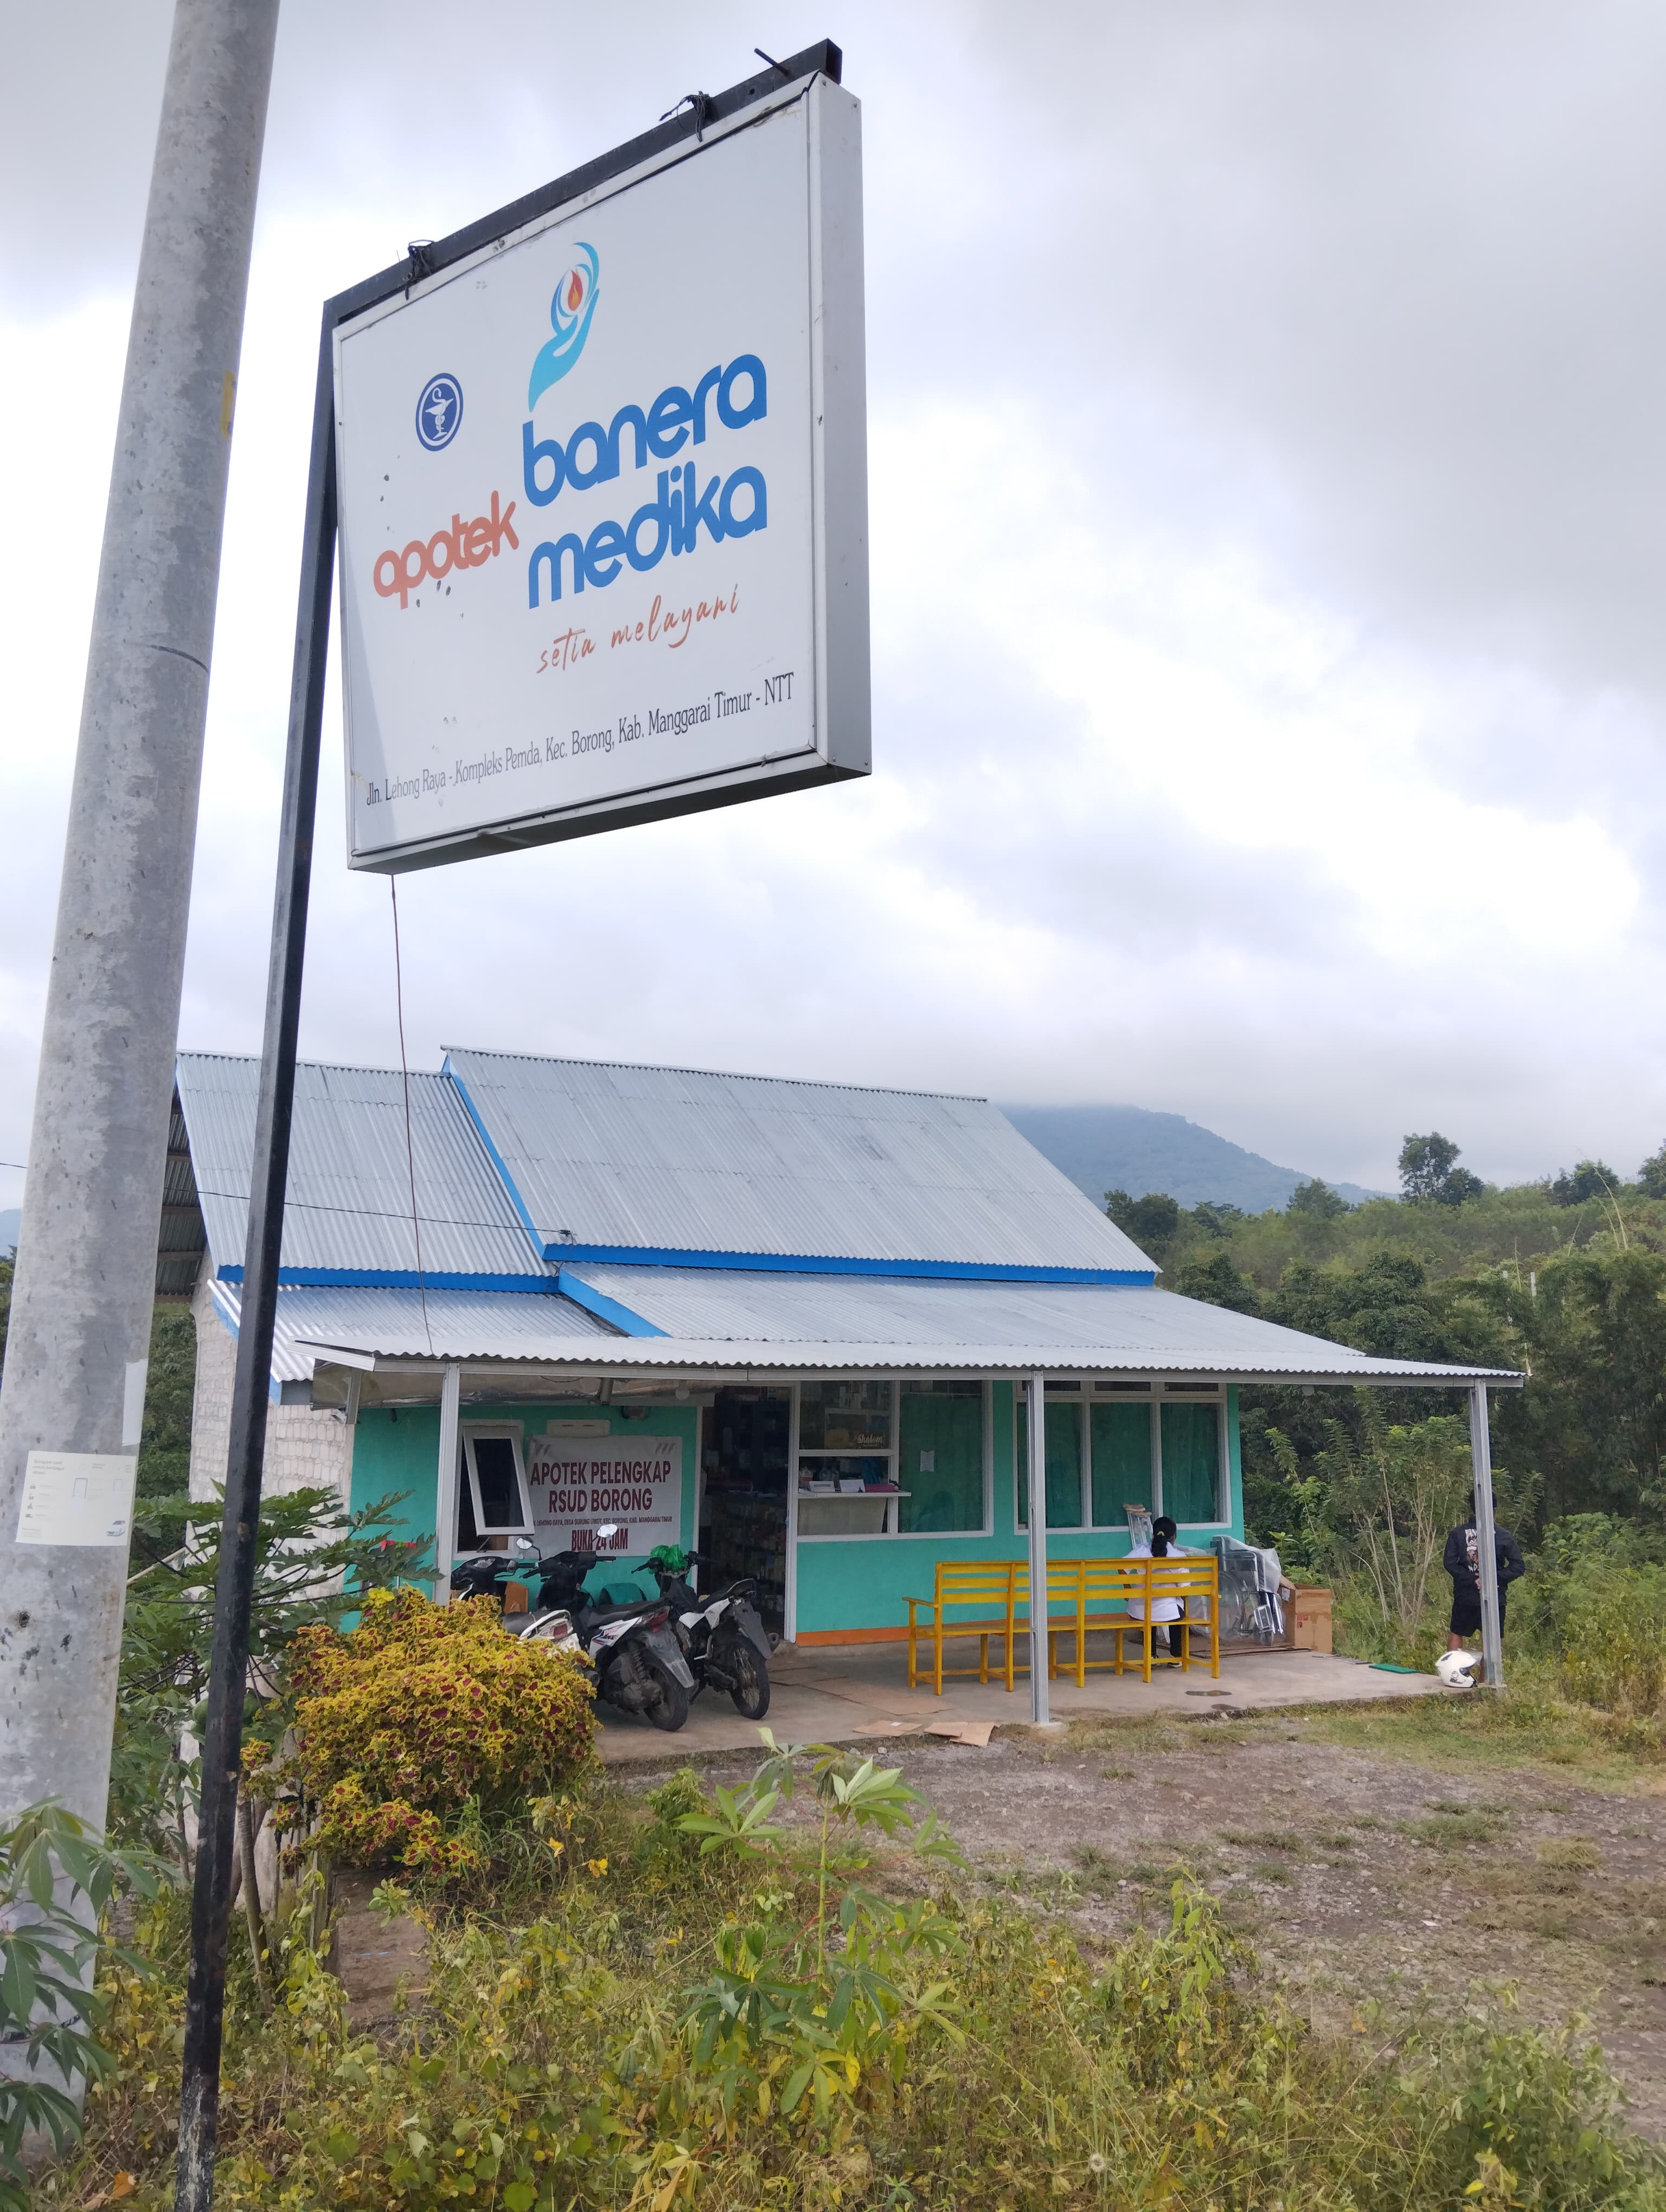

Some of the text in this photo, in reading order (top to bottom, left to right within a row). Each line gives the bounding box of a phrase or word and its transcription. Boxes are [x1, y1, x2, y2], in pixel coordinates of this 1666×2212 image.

[523, 353, 767, 507] banera
[373, 490, 520, 609] apotek
[529, 461, 767, 609] medika
[536, 583, 739, 673] setia melayani
[367, 782, 382, 806] Jln.
[385, 775, 420, 801] Lehong
[422, 769, 446, 794] Raya
[455, 751, 502, 784] Kompleks
[505, 741, 543, 771] Pemda,
[546, 736, 568, 762] Kec.
[572, 730, 615, 756] Borong,
[618, 715, 645, 743] Kab.
[648, 696, 711, 736] Manggarai
[714, 690, 752, 718] Timur
[764, 671, 794, 705] NTT
[530, 1460, 671, 1486] APOTEK PELENGKAP
[549, 1488, 652, 1513] RSUD BORONG
[571, 1529, 593, 1552] BUKA
[609, 1528, 629, 1550] JAM
